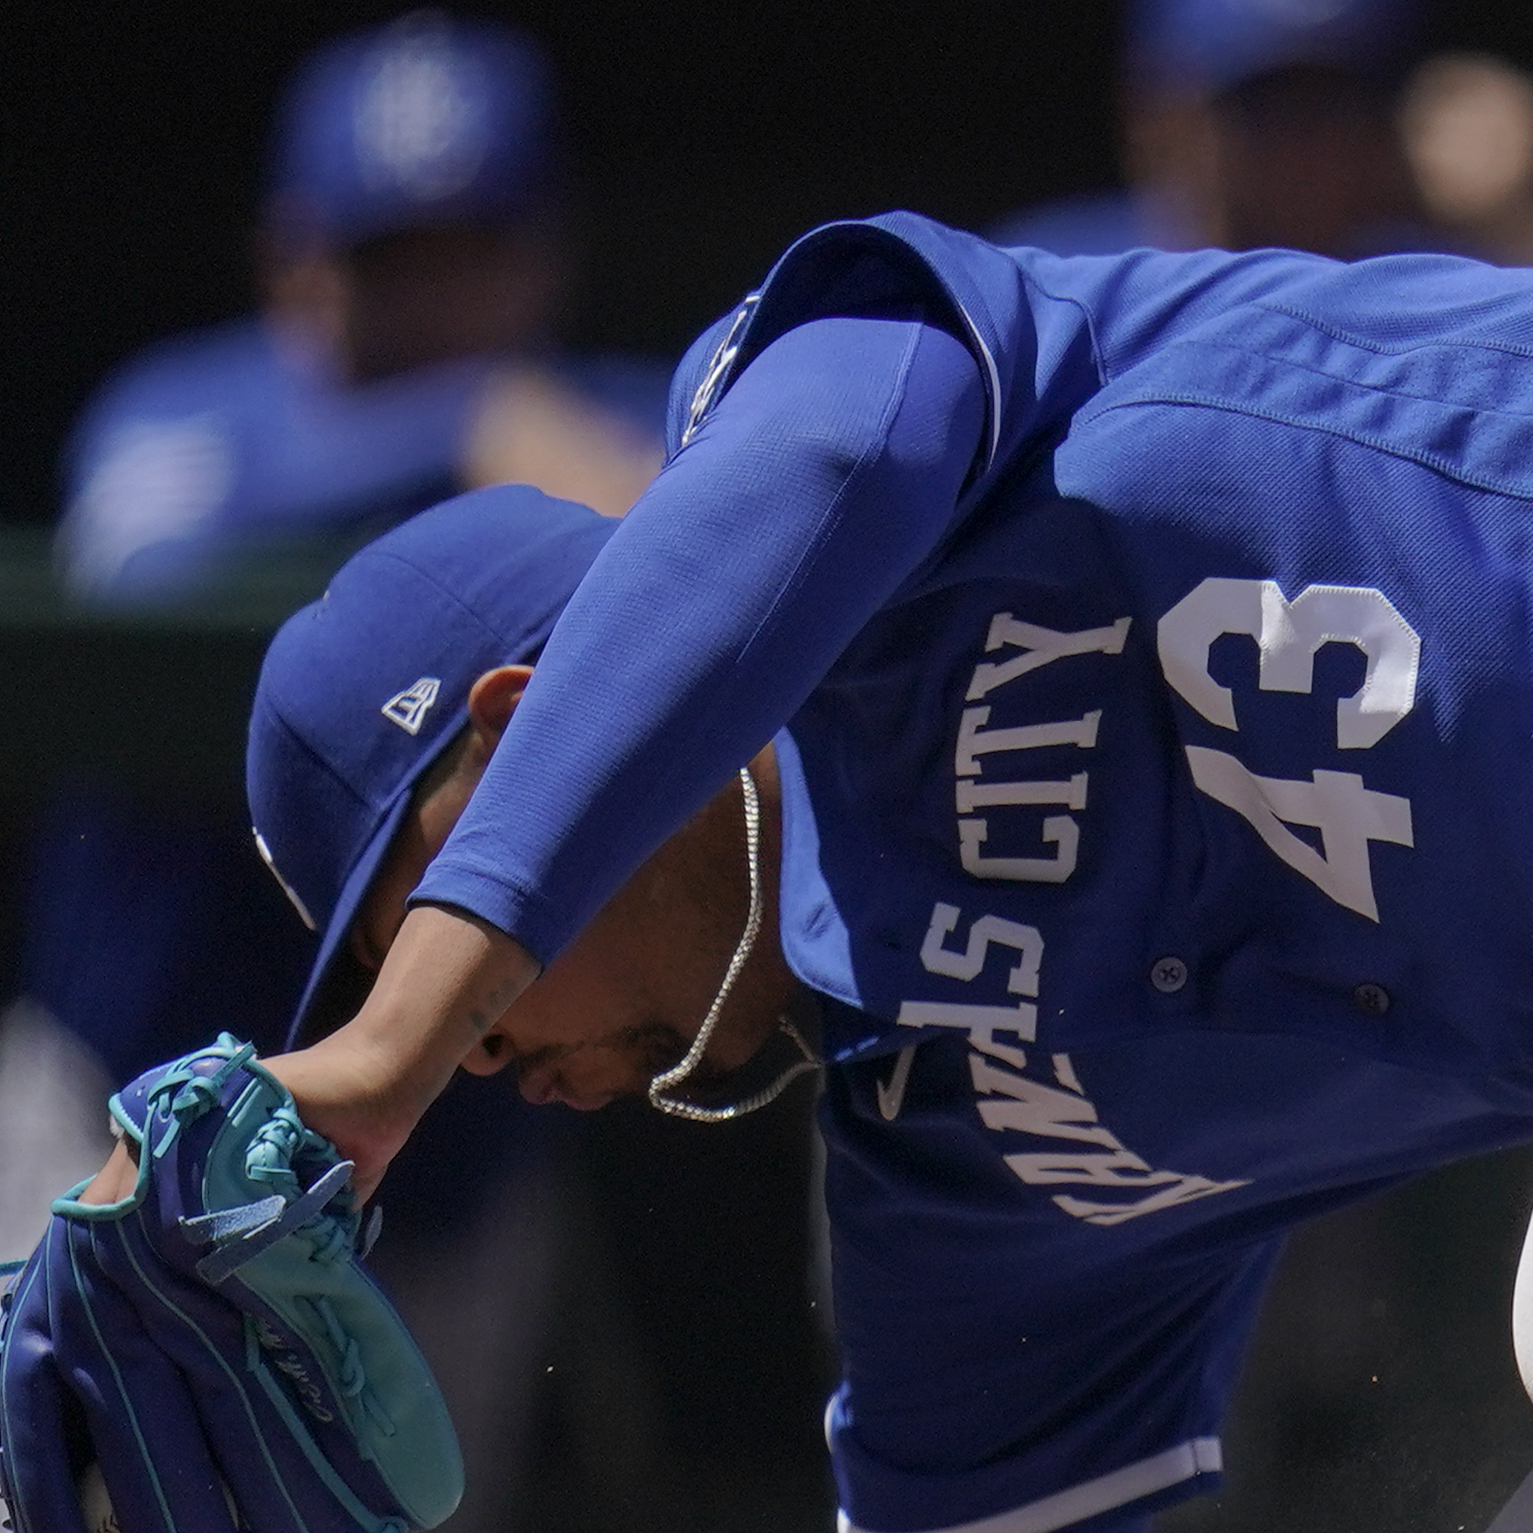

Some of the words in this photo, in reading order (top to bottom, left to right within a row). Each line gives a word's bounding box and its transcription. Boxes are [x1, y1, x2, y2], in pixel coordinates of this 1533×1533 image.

[954, 611, 1133, 883] CITY
[1156, 576, 1422, 925] 43
[897, 901, 1256, 1227] KANAS
